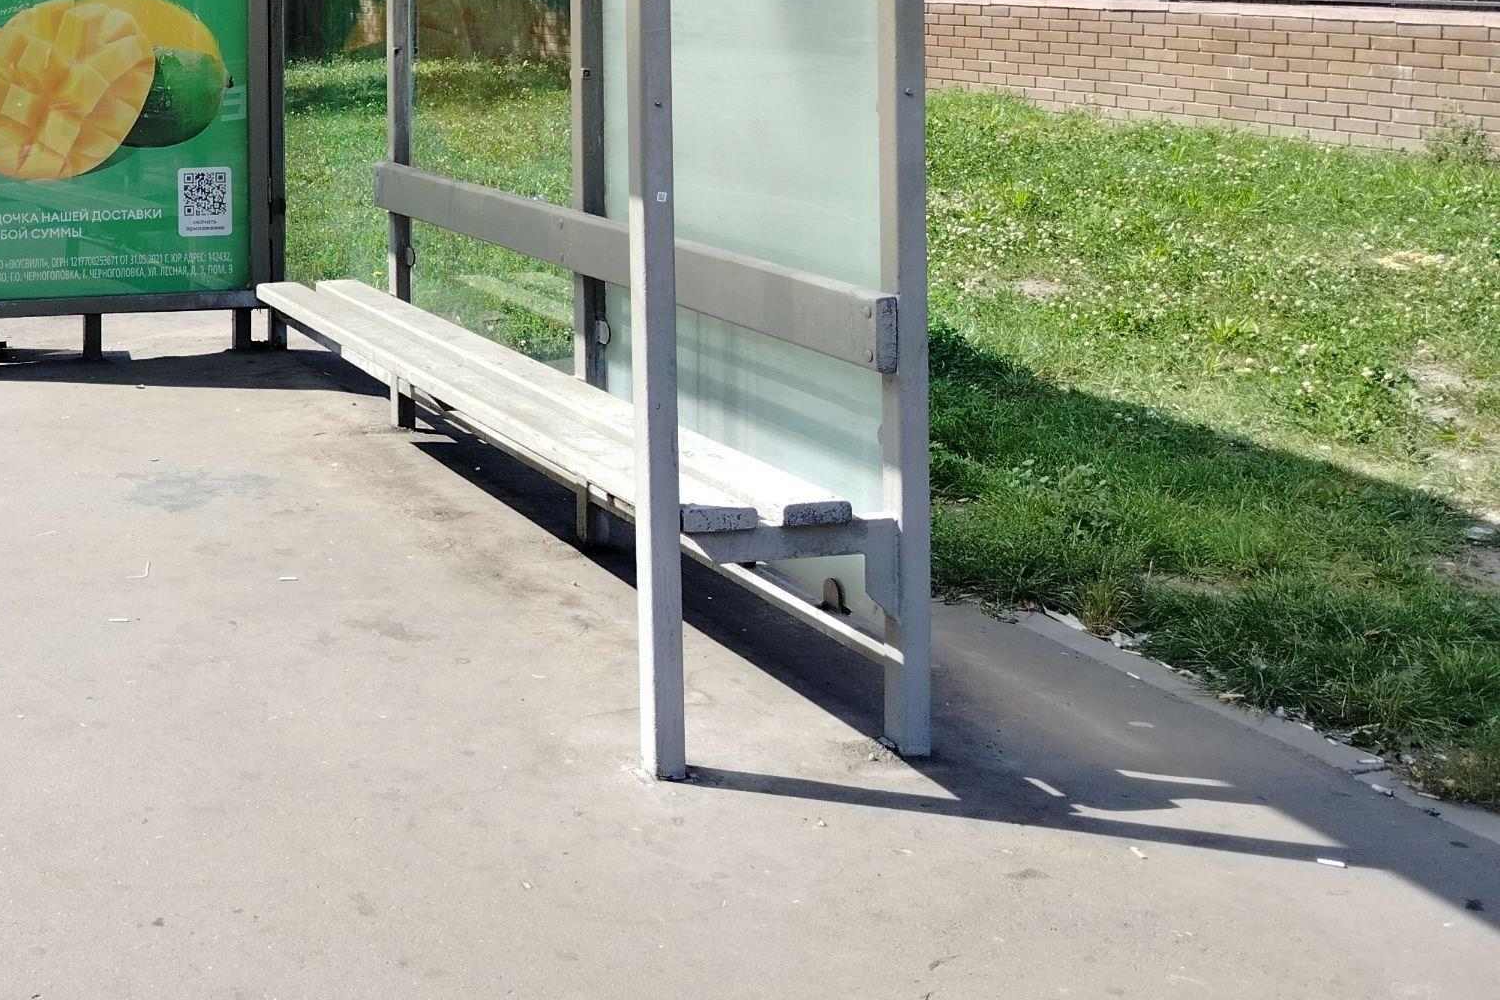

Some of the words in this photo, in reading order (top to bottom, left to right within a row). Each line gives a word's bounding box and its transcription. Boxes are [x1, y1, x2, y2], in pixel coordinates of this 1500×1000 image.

[41, 209, 89, 223] НАШЕЙ
[92, 208, 162, 222] ДОСТАВКИ
[31, 227, 82, 240] СУММЫ
